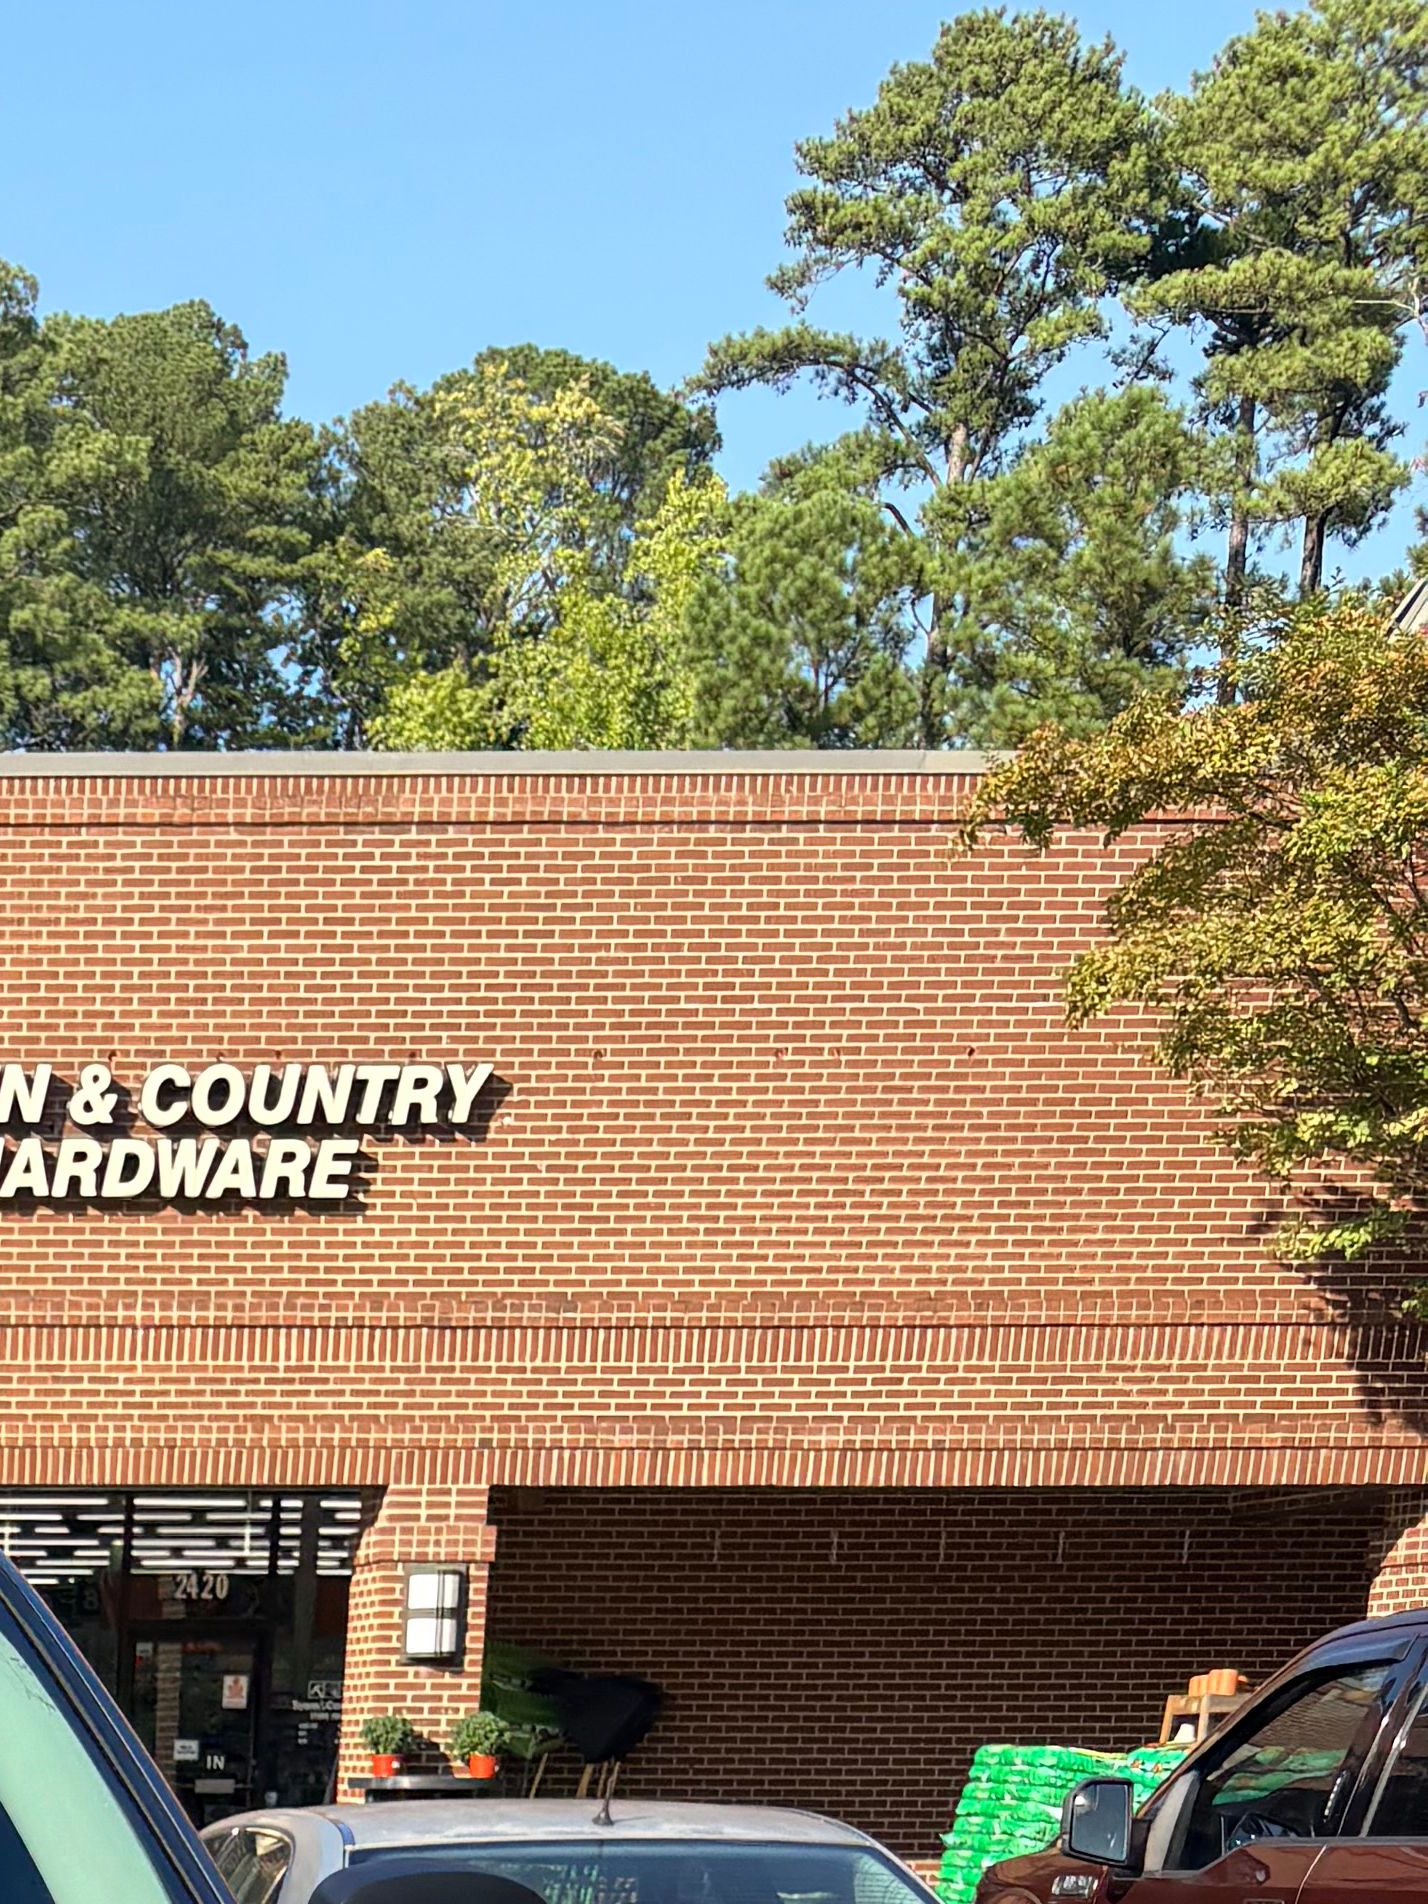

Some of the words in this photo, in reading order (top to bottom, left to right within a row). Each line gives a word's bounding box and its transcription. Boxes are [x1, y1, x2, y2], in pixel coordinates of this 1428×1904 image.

[68, 1062, 120, 1127] &
[140, 1062, 495, 1127] COUNTRY
[174, 1574, 229, 1600] 2420
[206, 1754, 225, 1770] IN
